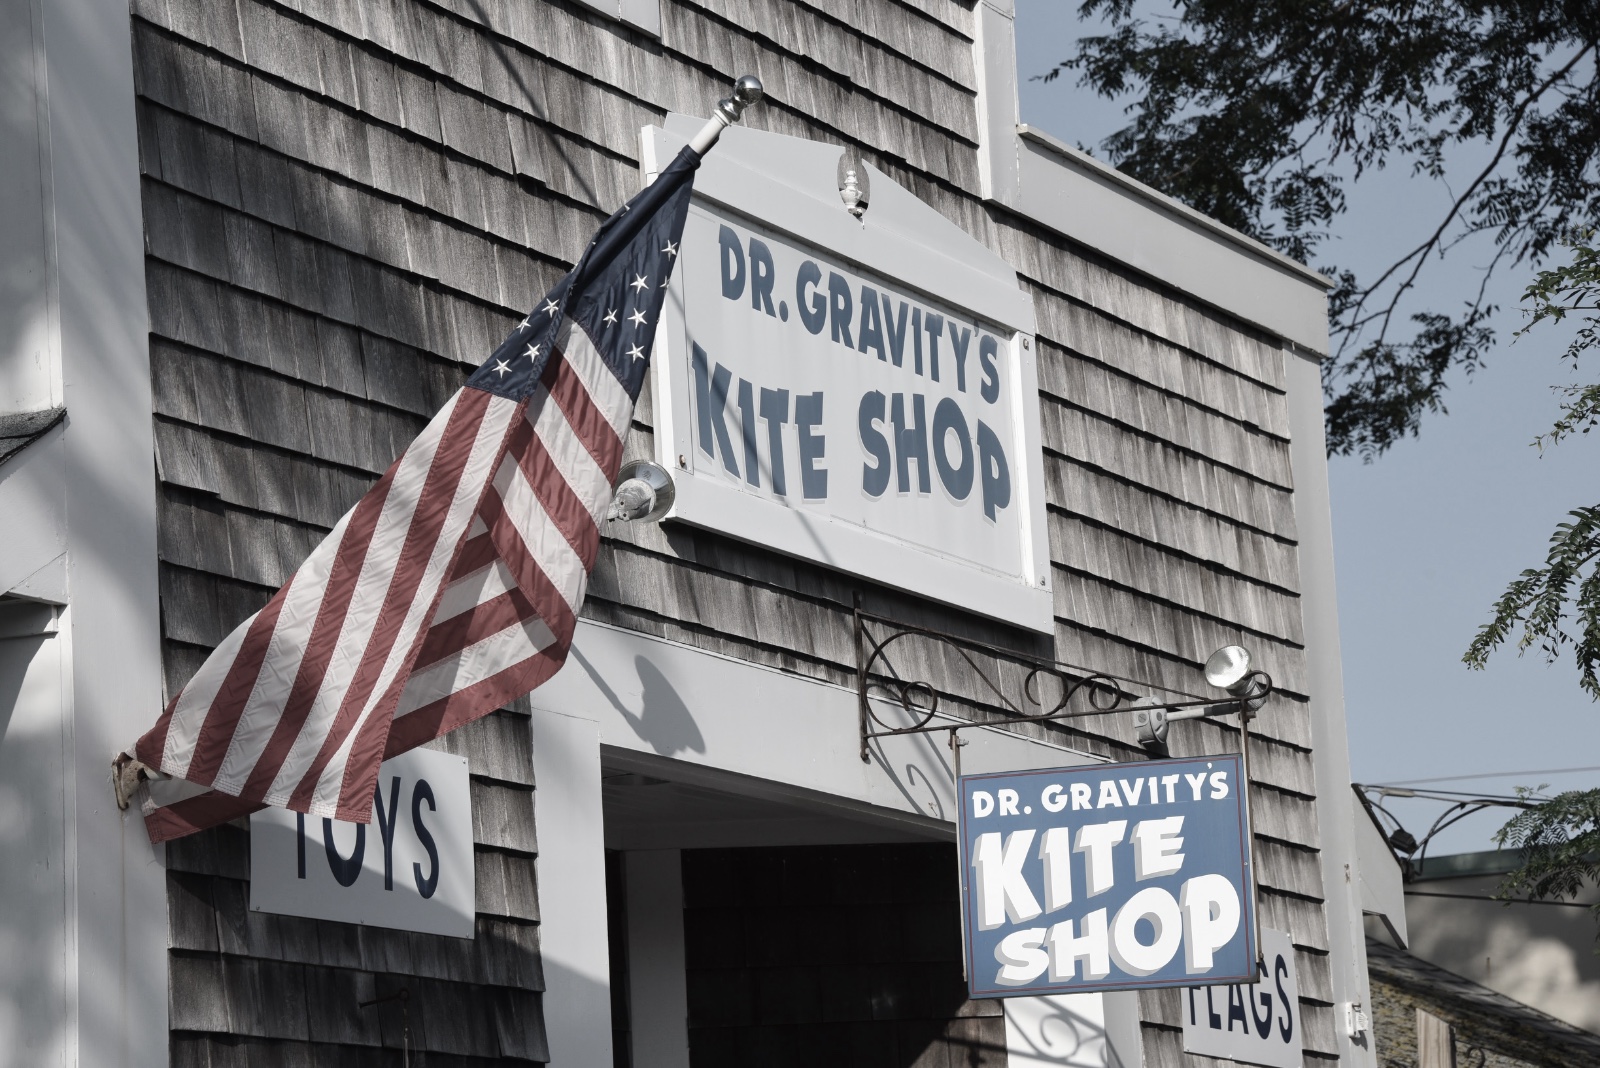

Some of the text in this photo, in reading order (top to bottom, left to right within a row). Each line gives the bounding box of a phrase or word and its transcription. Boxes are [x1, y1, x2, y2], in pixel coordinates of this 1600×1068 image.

[718, 224, 1000, 404] DR. GRAVITY'S
[691, 340, 1011, 524] KITE SHOP
[972, 762, 1229, 818] DR. GRAVITY'S
[972, 816, 1185, 931] KITE
[994, 874, 1240, 986] SHOP
